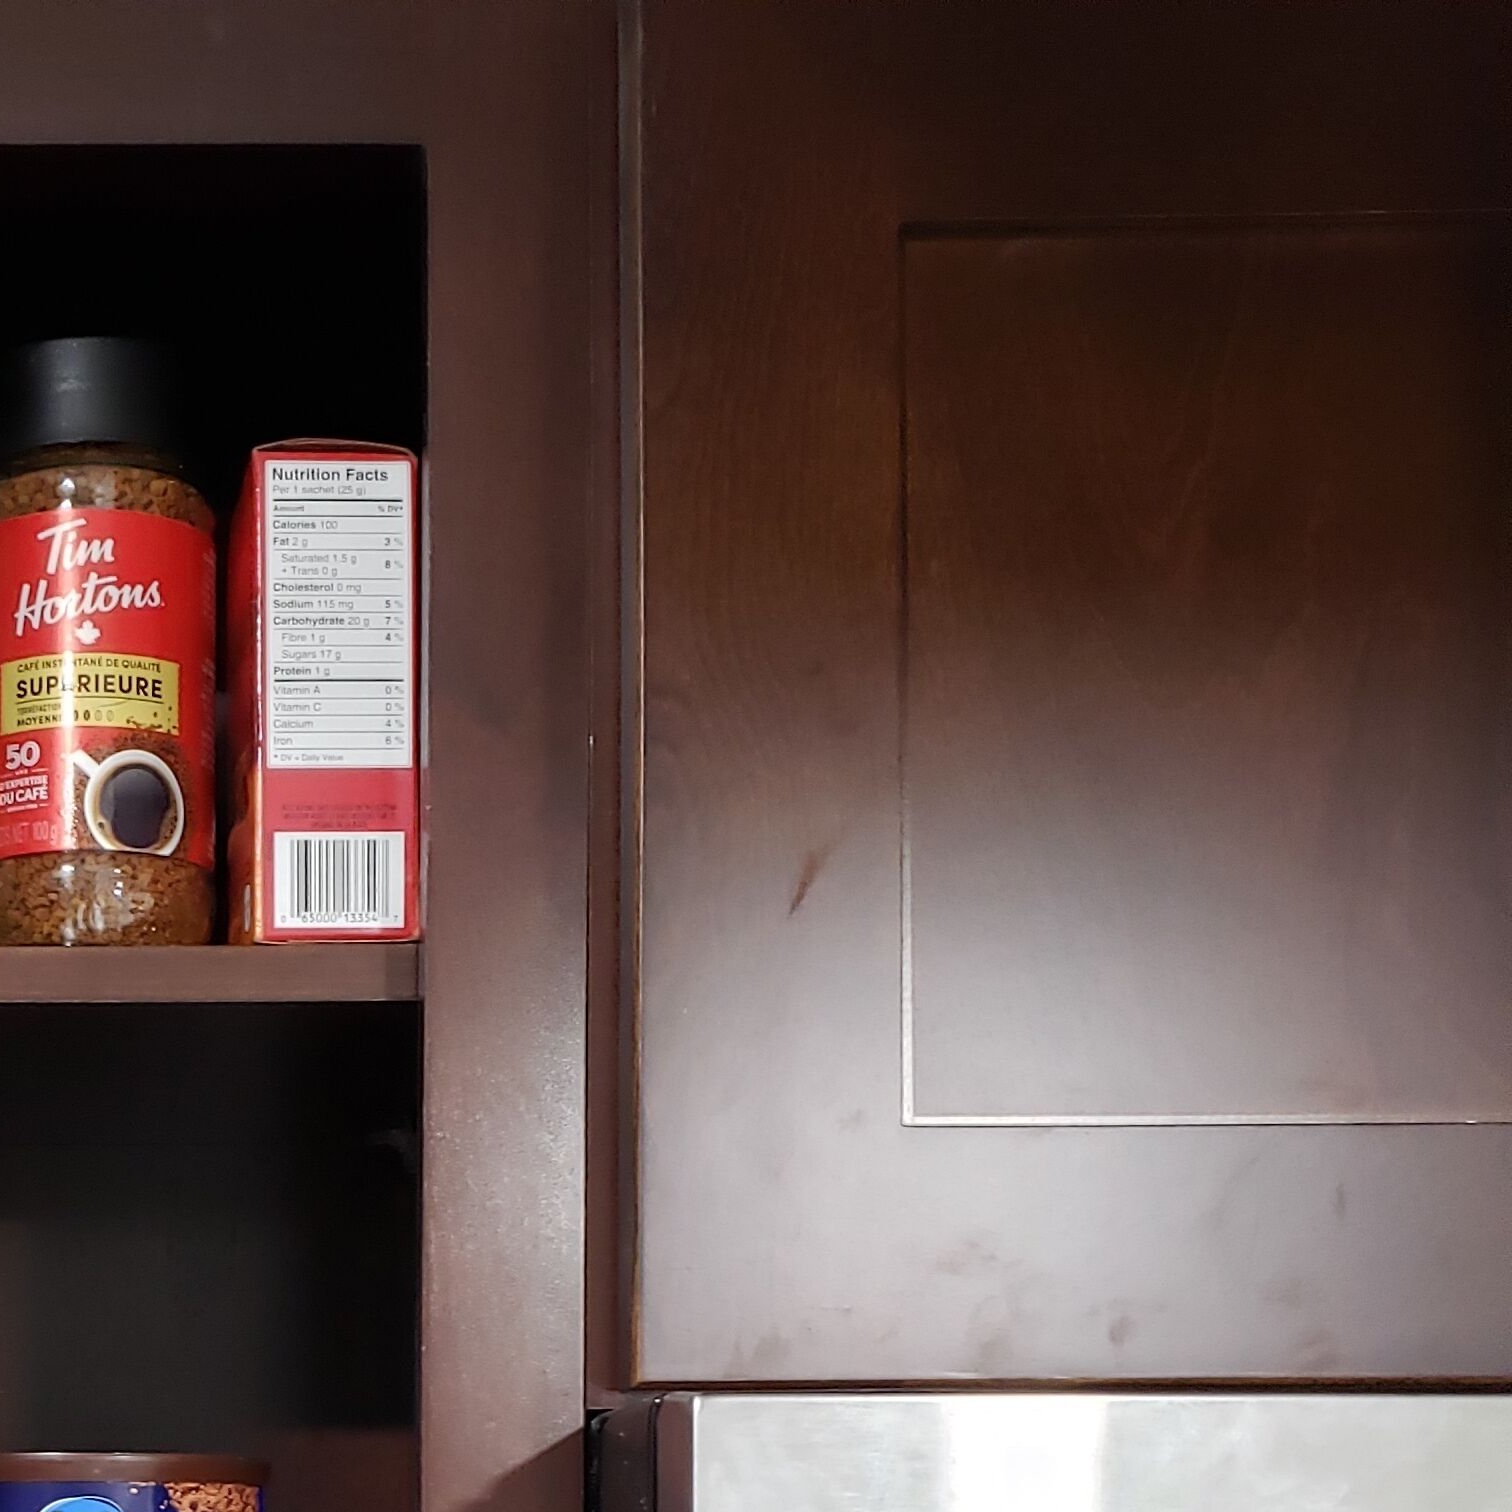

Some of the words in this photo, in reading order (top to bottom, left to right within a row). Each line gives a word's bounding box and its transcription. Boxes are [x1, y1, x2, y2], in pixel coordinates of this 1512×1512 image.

[272, 468, 340, 481] Nutrition
[346, 468, 389, 481] Facts
[273, 485, 289, 494] Per
[302, 486, 334, 494] sachet
[273, 520, 316, 530] Calories
[320, 520, 338, 530] 100
[37, 518, 115, 575] Tim
[273, 537, 289, 546] Fat
[282, 554, 329, 563] Saturated
[291, 566, 319, 575] Trans
[274, 582, 334, 592] Cholesterol
[346, 584, 362, 593] mg
[14, 572, 162, 637] Hortons
[274, 600, 314, 609] Sodium
[338, 602, 354, 610] mg
[274, 616, 344, 627] Carbohydrate
[348, 617, 360, 625] 20
[282, 633, 307, 642] Fibre
[282, 650, 316, 660] Sugars
[17, 661, 39, 673] CAFÉ
[42, 656, 102, 669] INSTNTANÉ
[106, 658, 118, 668] DE
[122, 660, 162, 672] QUALITÉ
[274, 666, 311, 676] Protein
[274, 686, 310, 694] Vitamin
[17, 702, 62, 715] TORRÉFACTIO
[274, 703, 310, 711] Vitamin
[17, 714, 63, 728] MOYENN
[274, 720, 314, 728] Calcium
[274, 737, 292, 745] Iron
[6, 741, 40, 770] 50
[0, 791, 14, 806] DU
[16, 785, 48, 802] CAFÉ
[302, 913, 337, 923] 65000
